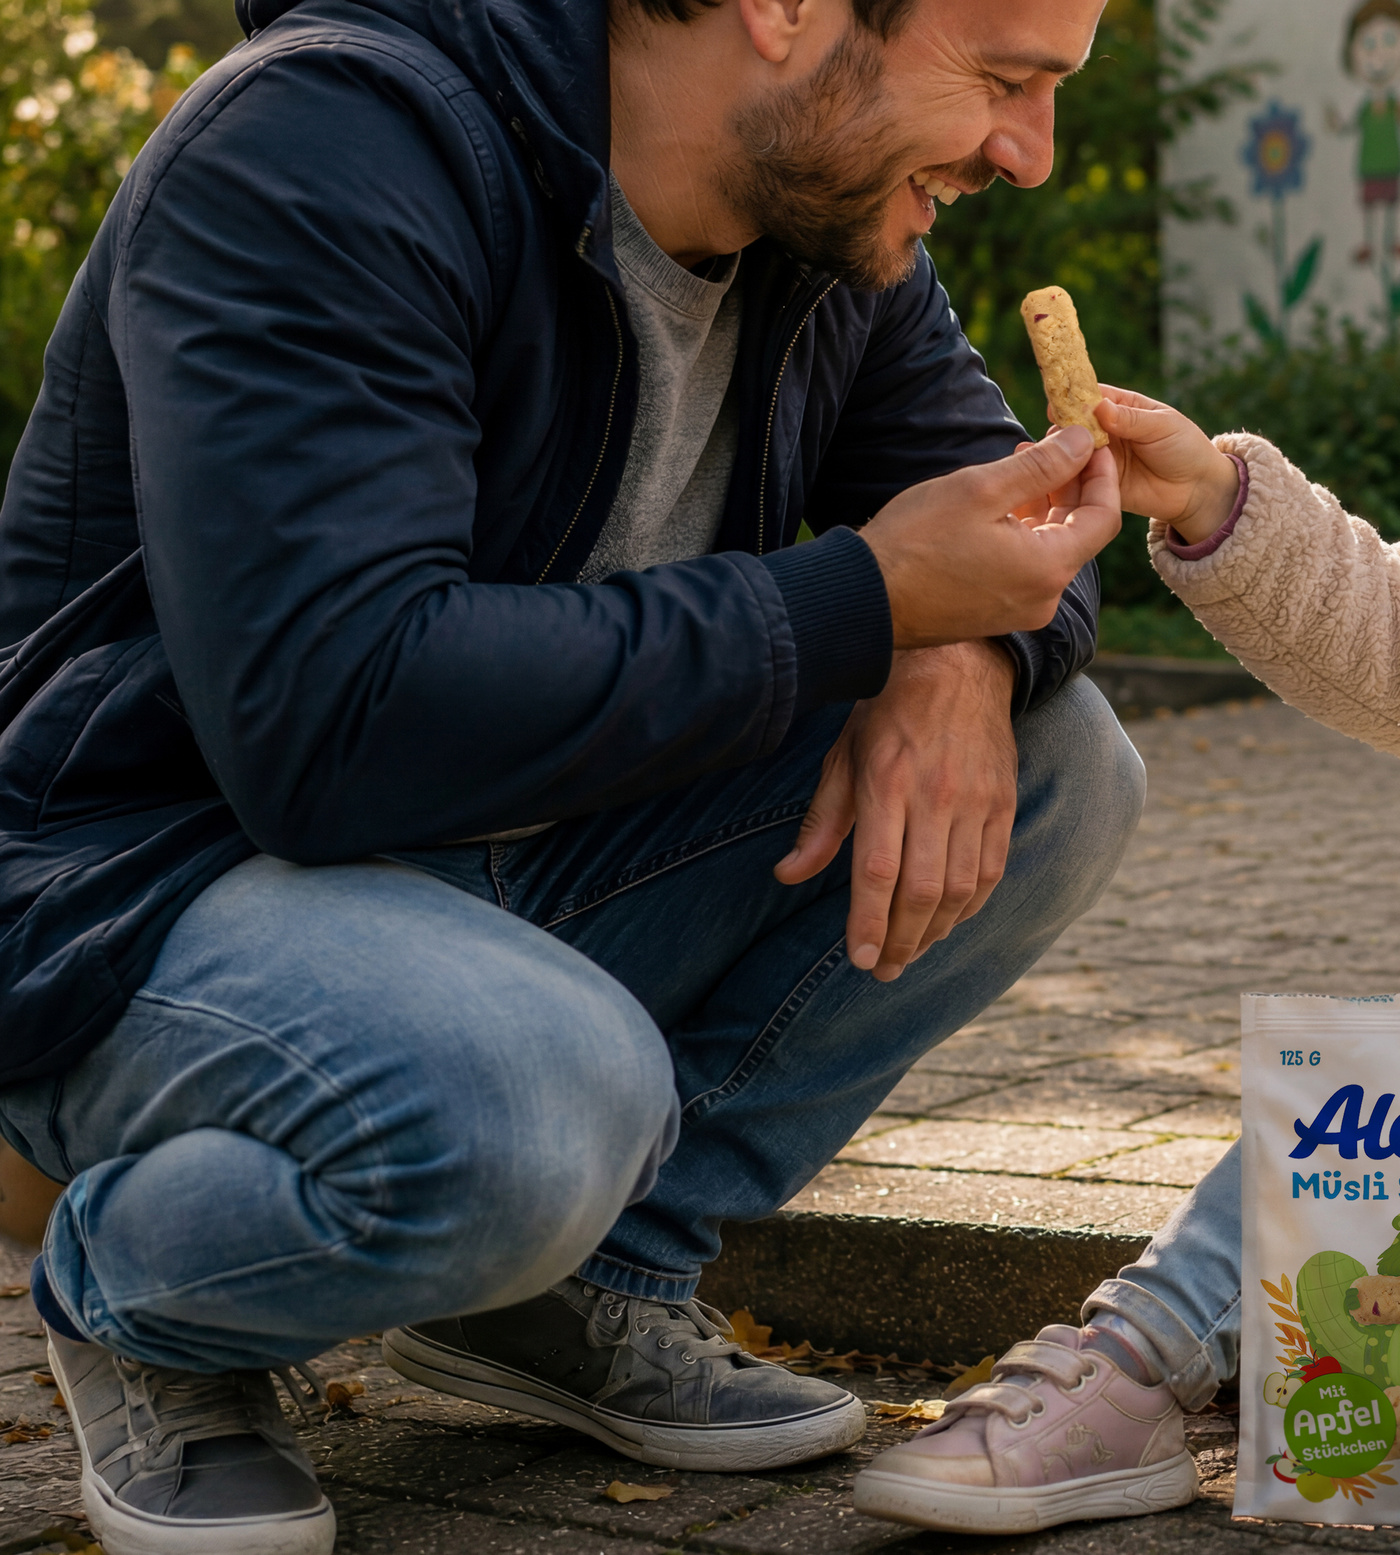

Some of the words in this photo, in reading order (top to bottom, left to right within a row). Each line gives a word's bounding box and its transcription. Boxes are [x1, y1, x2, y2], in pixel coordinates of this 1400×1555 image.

[1279, 1050, 1304, 1066] 125
[1309, 1050, 1321, 1066] G
[1292, 1170, 1389, 1201] Müsli
[1318, 1384, 1347, 1400] Mit
[1293, 1399, 1381, 1442] Apfel
[1302, 1439, 1387, 1461] Stückchen
